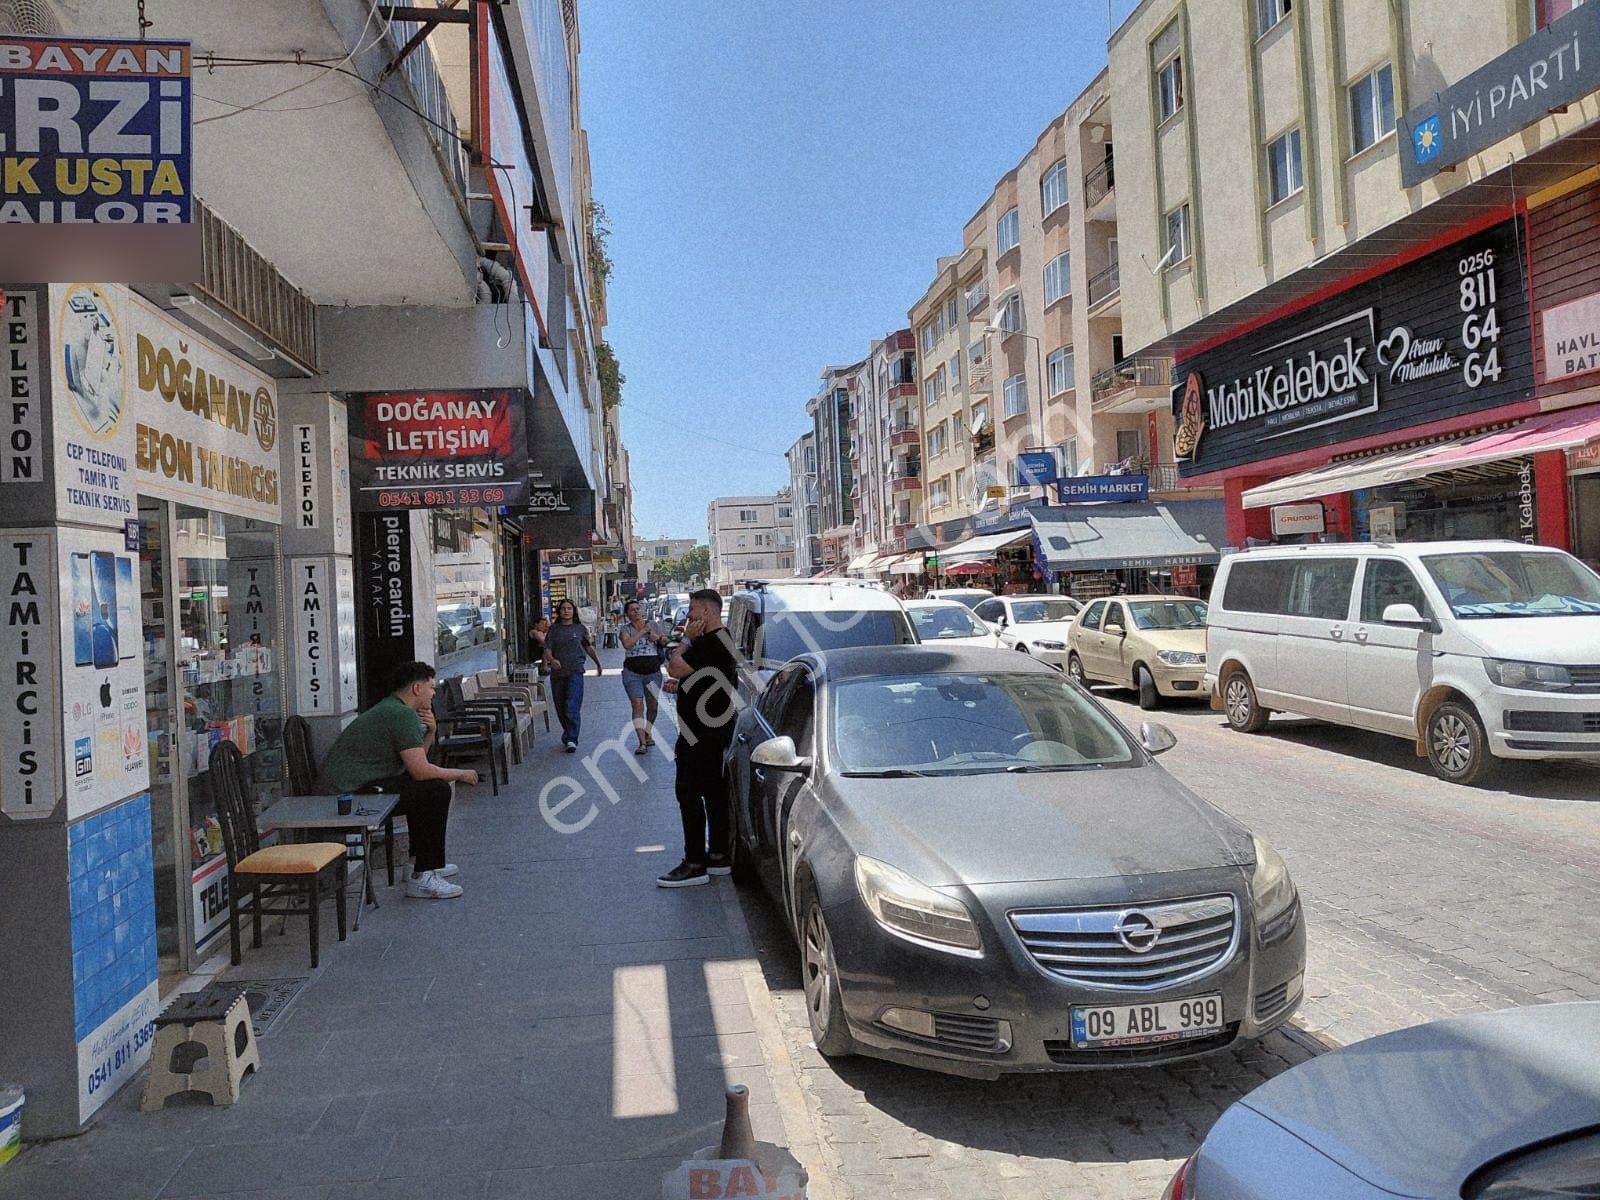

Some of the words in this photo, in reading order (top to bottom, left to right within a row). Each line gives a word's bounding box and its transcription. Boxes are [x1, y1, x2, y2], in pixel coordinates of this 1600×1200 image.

[0, 45, 181, 74] BAYAN
[1450, 90, 1483, 140] İYİ
[1489, 30, 1581, 120] PARTİ
[55, 158, 184, 195] USTA
[1458, 249, 1494, 276] 0256
[1460, 268, 1496, 312] 811
[1462, 308, 1501, 350] 64
[1408, 336, 1443, 360] Artan
[1463, 347, 1502, 388] 64
[6, 295, 32, 479] TELEFON
[137, 333, 251, 436] DOĞANAY
[1207, 337, 1369, 430] MobiKelebek
[377, 397, 497, 422] DOĞANAY
[387, 425, 490, 455] İLETİŞİM
[66, 442, 84, 461] CEP
[86, 447, 127, 473] TELEFONU
[376, 462, 441, 481] TEKNİK
[444, 460, 504, 478] SERVİS
[78, 467, 107, 490] TAMİR
[108, 474, 120, 491] VE
[299, 426, 314, 527] TELEFON
[1063, 482, 1097, 495] SEMİH
[1100, 482, 1144, 494] MARKET
[66, 487, 101, 510] TEKNİK
[103, 493, 131, 514] SERVİS
[378, 492, 421, 507] 0541
[424, 491, 456, 505] 811
[459, 489, 480, 504] 33
[482, 488, 504, 503] 69
[1517, 462, 1534, 529] Kelebek
[1280, 513, 1319, 523] GRUNDIG
[382, 516, 404, 572] pierre
[557, 554, 585, 563] NECLA
[1122, 559, 1152, 567] SEMİH
[1164, 557, 1203, 565] MARKET
[371, 550, 384, 606] YATAK
[388, 577, 411, 637] cardin
[82, 702, 92, 717] LG
[124, 759, 144, 773] HUAWEI
[1075, 1026, 1085, 1035] TR
[1088, 1010, 1115, 1037] 09
[1127, 1006, 1167, 1034] ABL
[1179, 999, 1218, 1028] 999
[88, 1056, 112, 1095] 0541
[115, 1039, 131, 1070] 811
[133, 1020, 154, 1053] 3369
